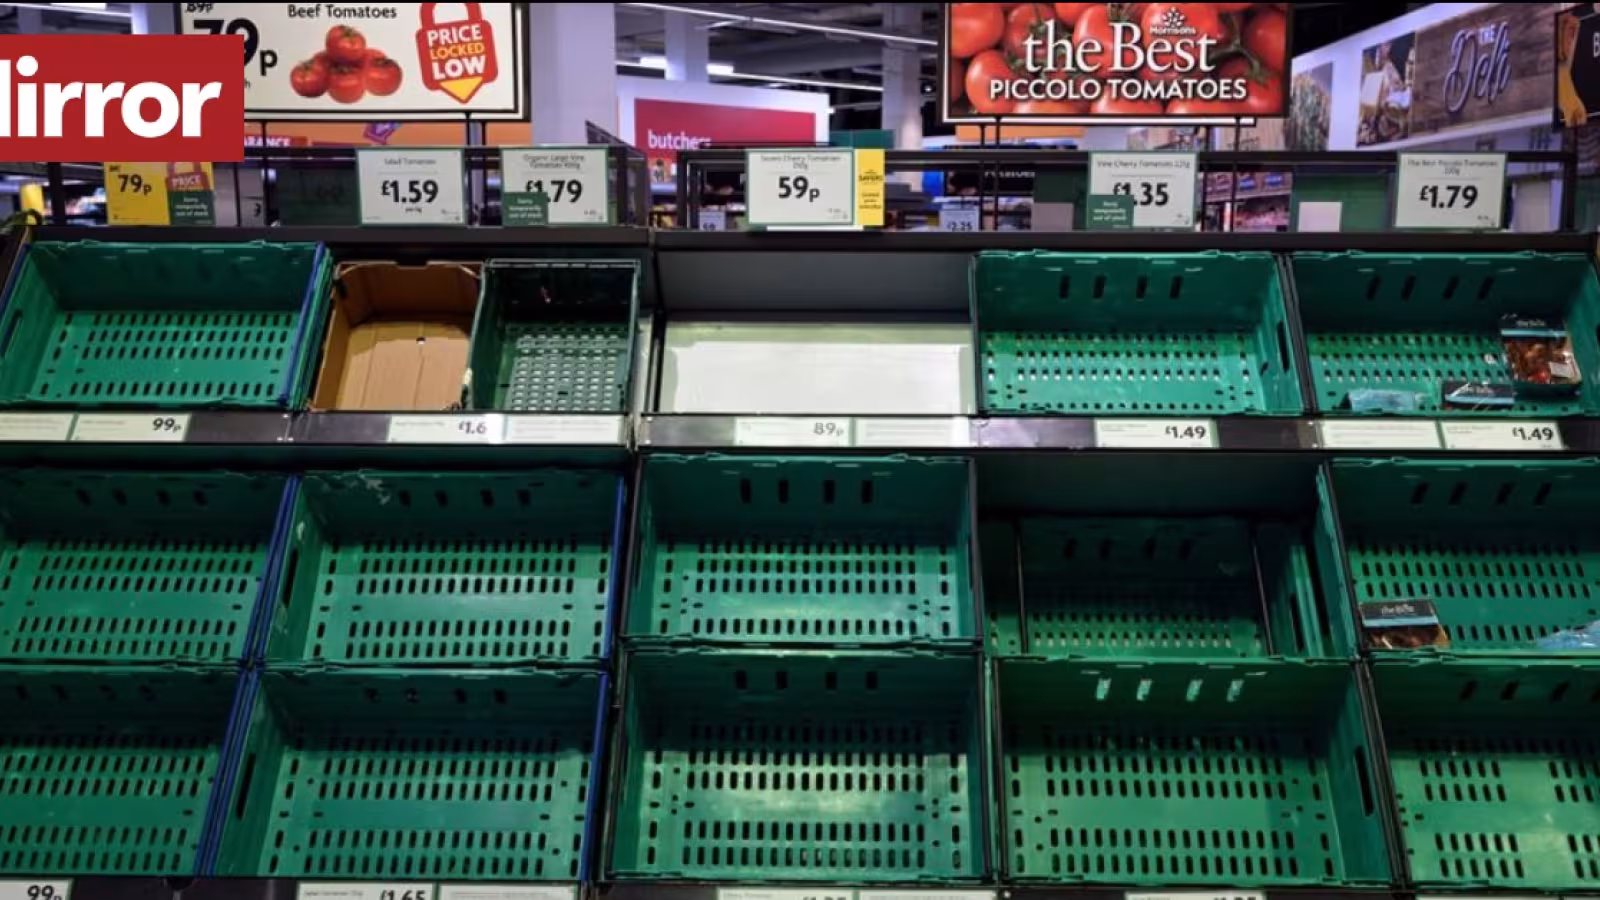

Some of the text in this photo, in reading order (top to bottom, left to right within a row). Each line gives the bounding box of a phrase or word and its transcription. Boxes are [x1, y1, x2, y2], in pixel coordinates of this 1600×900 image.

[288, 5, 397, 18] Beef Tomatoes
[427, 24, 483, 46] PRICE
[1022, 19, 1216, 72] the Best
[430, 43, 485, 60] LOCKED
[432, 56, 486, 80] LOW
[990, 79, 1247, 99] PICCOLO TOMATOES
[117, 173, 152, 196] 79p
[381, 180, 438, 203] £1.59
[778, 175, 821, 202] 59p
[1420, 185, 1479, 209] £1.79
[153, 417, 182, 433] 99p
[813, 422, 844, 436] 89p
[1166, 425, 1206, 439] £1.49
[1512, 426, 1554, 441] £1.49
